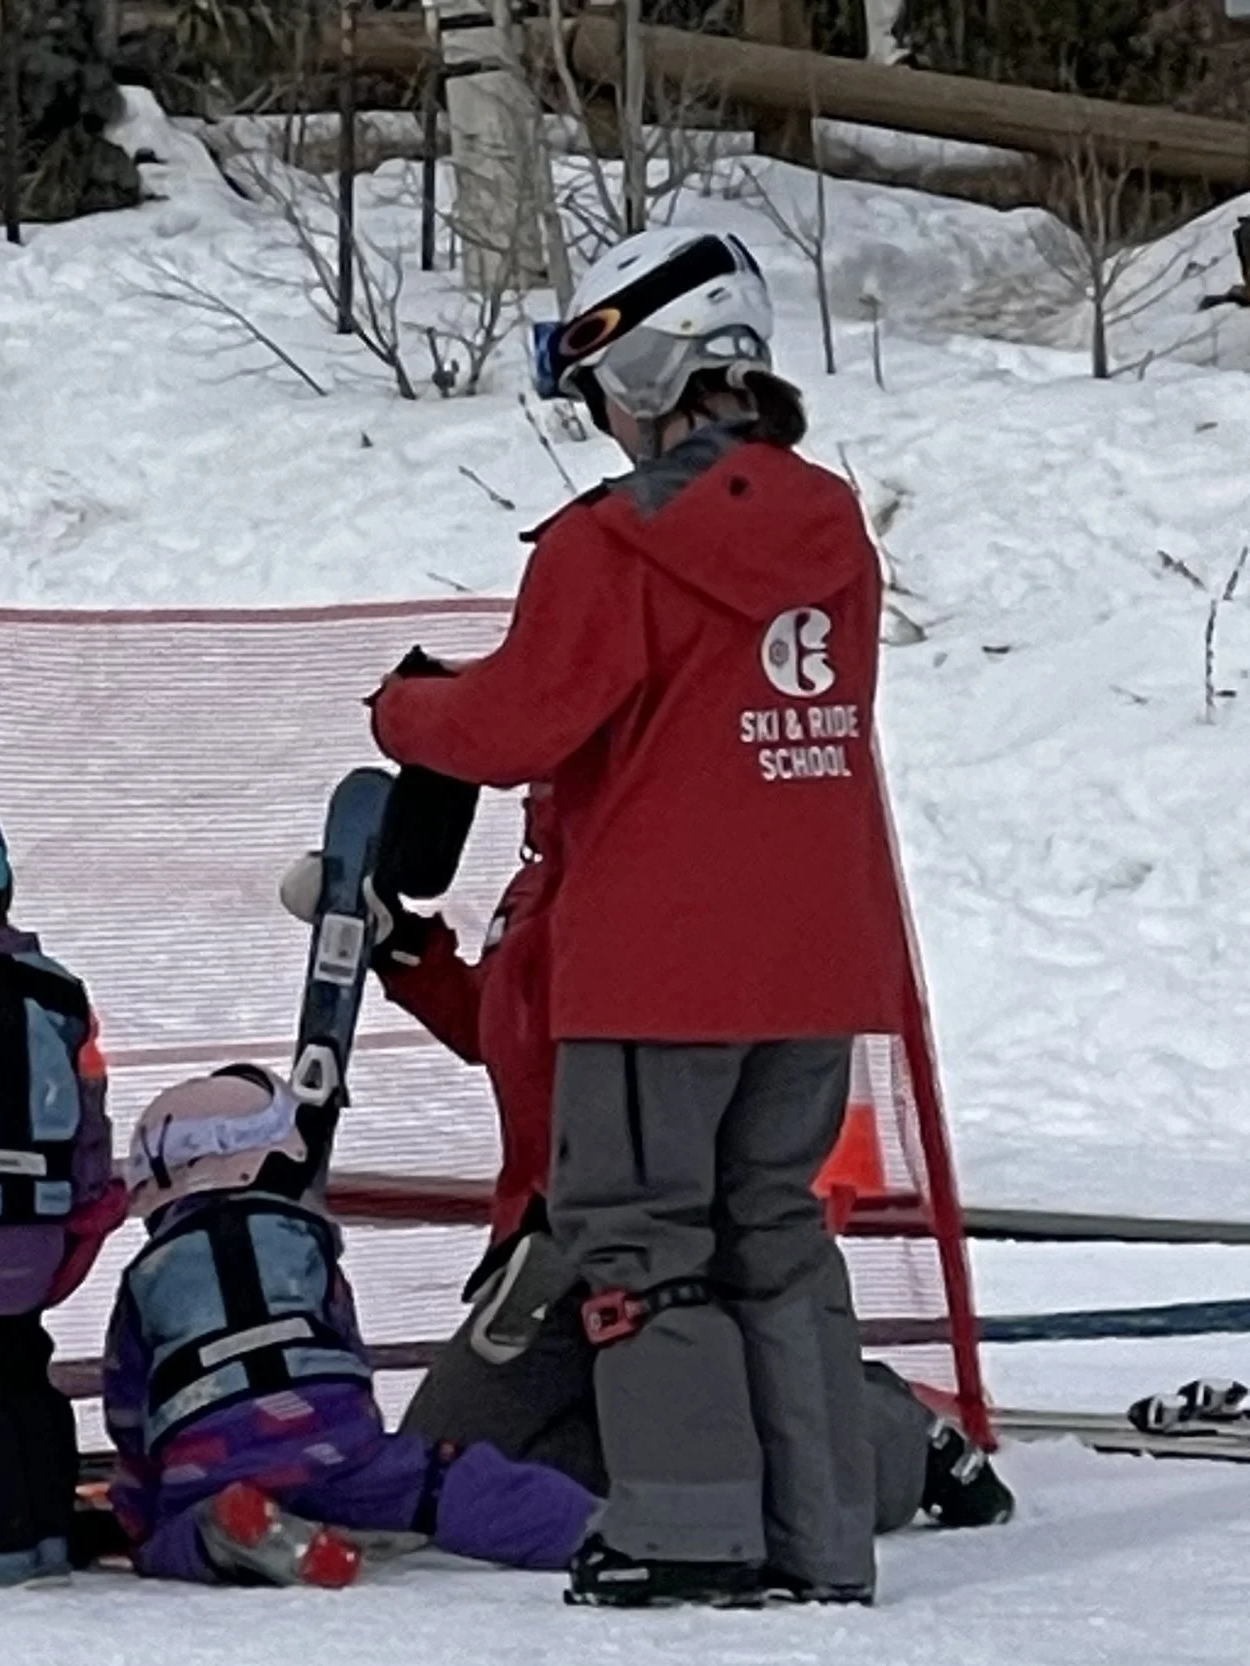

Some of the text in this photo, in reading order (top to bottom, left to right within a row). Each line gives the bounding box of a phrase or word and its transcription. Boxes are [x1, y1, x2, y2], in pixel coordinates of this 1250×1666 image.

[740, 705, 859, 742] SKI & RIDE
[758, 745, 852, 781] SCHOOL
